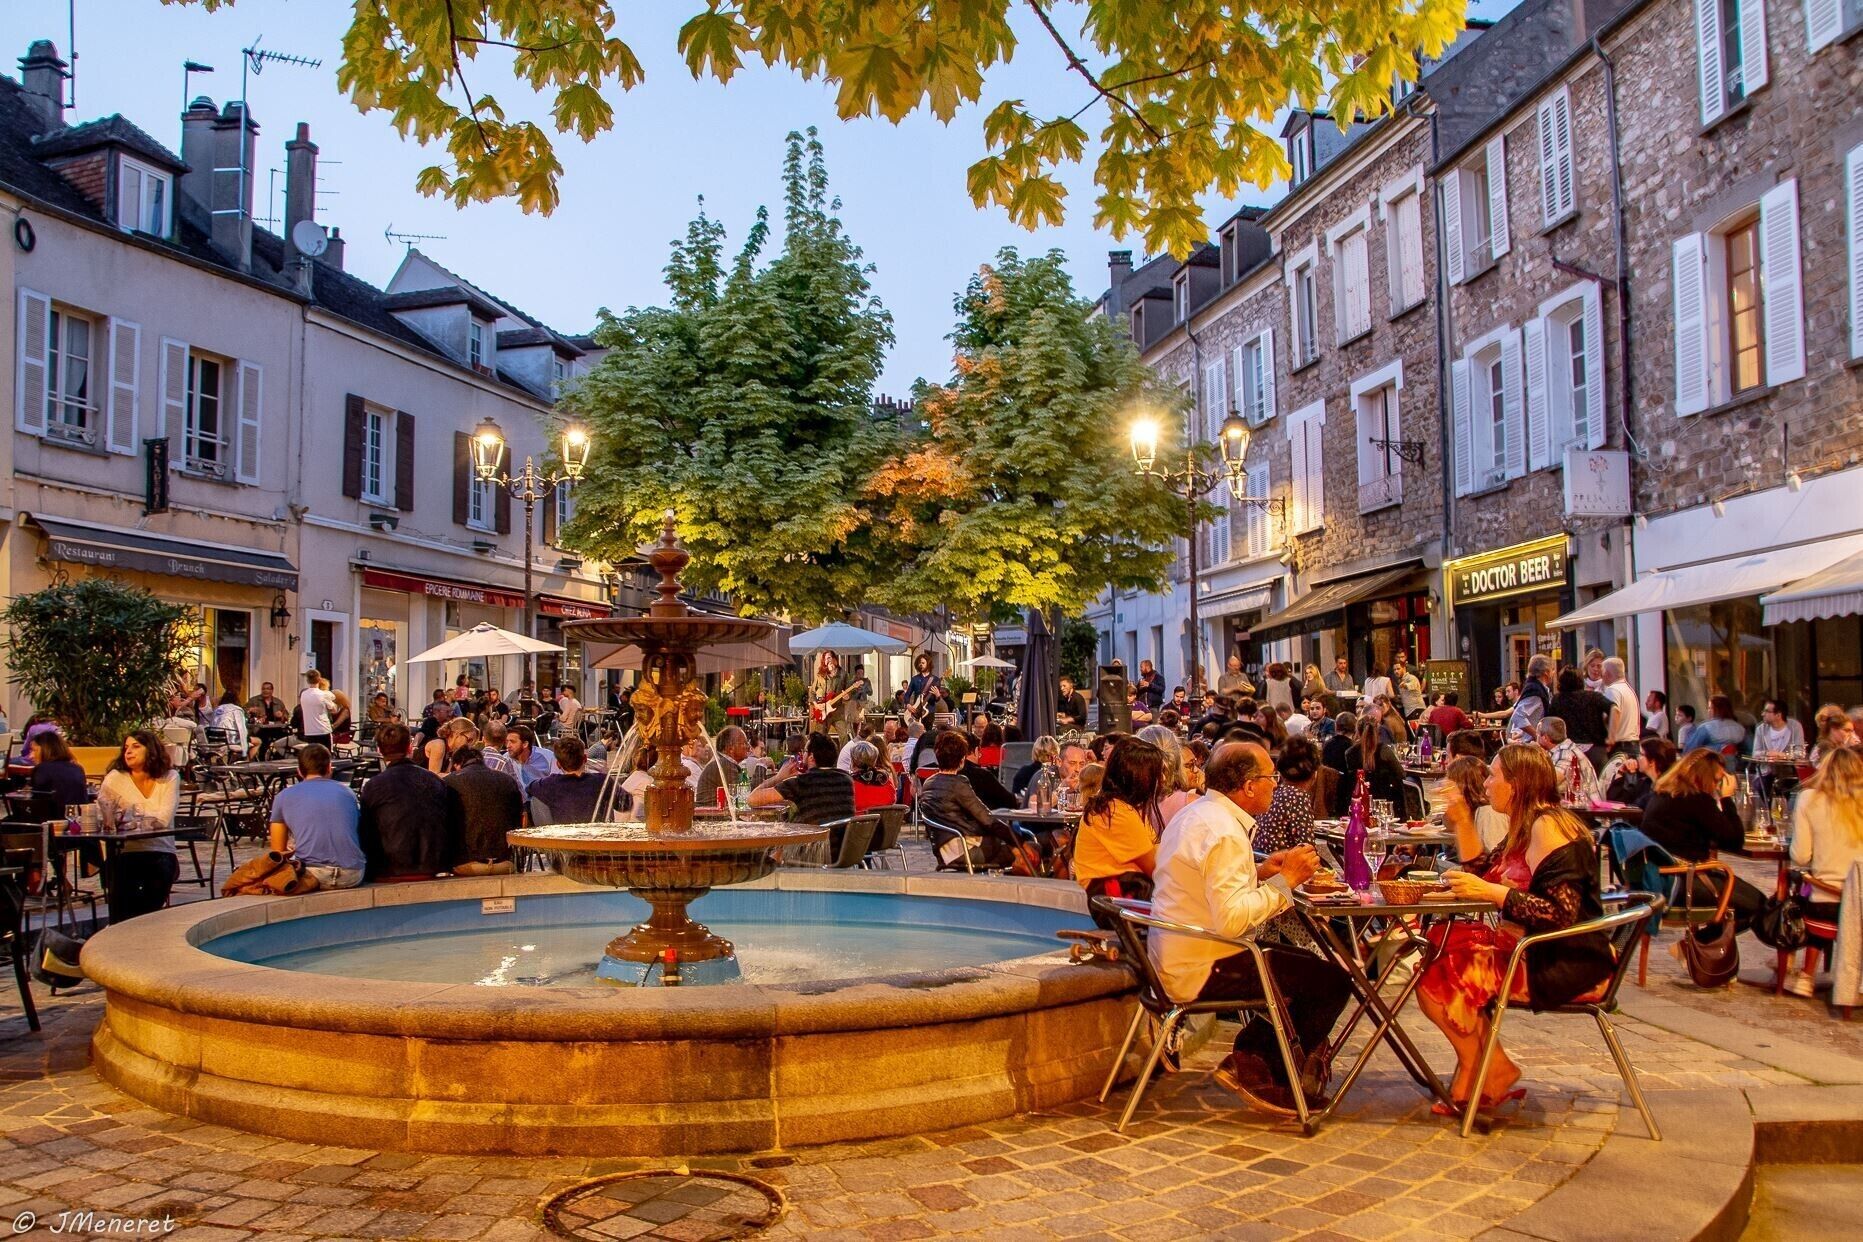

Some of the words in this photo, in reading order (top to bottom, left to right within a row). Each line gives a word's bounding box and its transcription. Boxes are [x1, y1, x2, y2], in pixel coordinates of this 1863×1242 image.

[54, 542, 115, 561] Restaurant
[167, 559, 205, 575] Brunch
[1471, 563, 1517, 594] DOCTOR
[1520, 555, 1550, 584] BEER
[425, 582, 452, 598] EPICERIE
